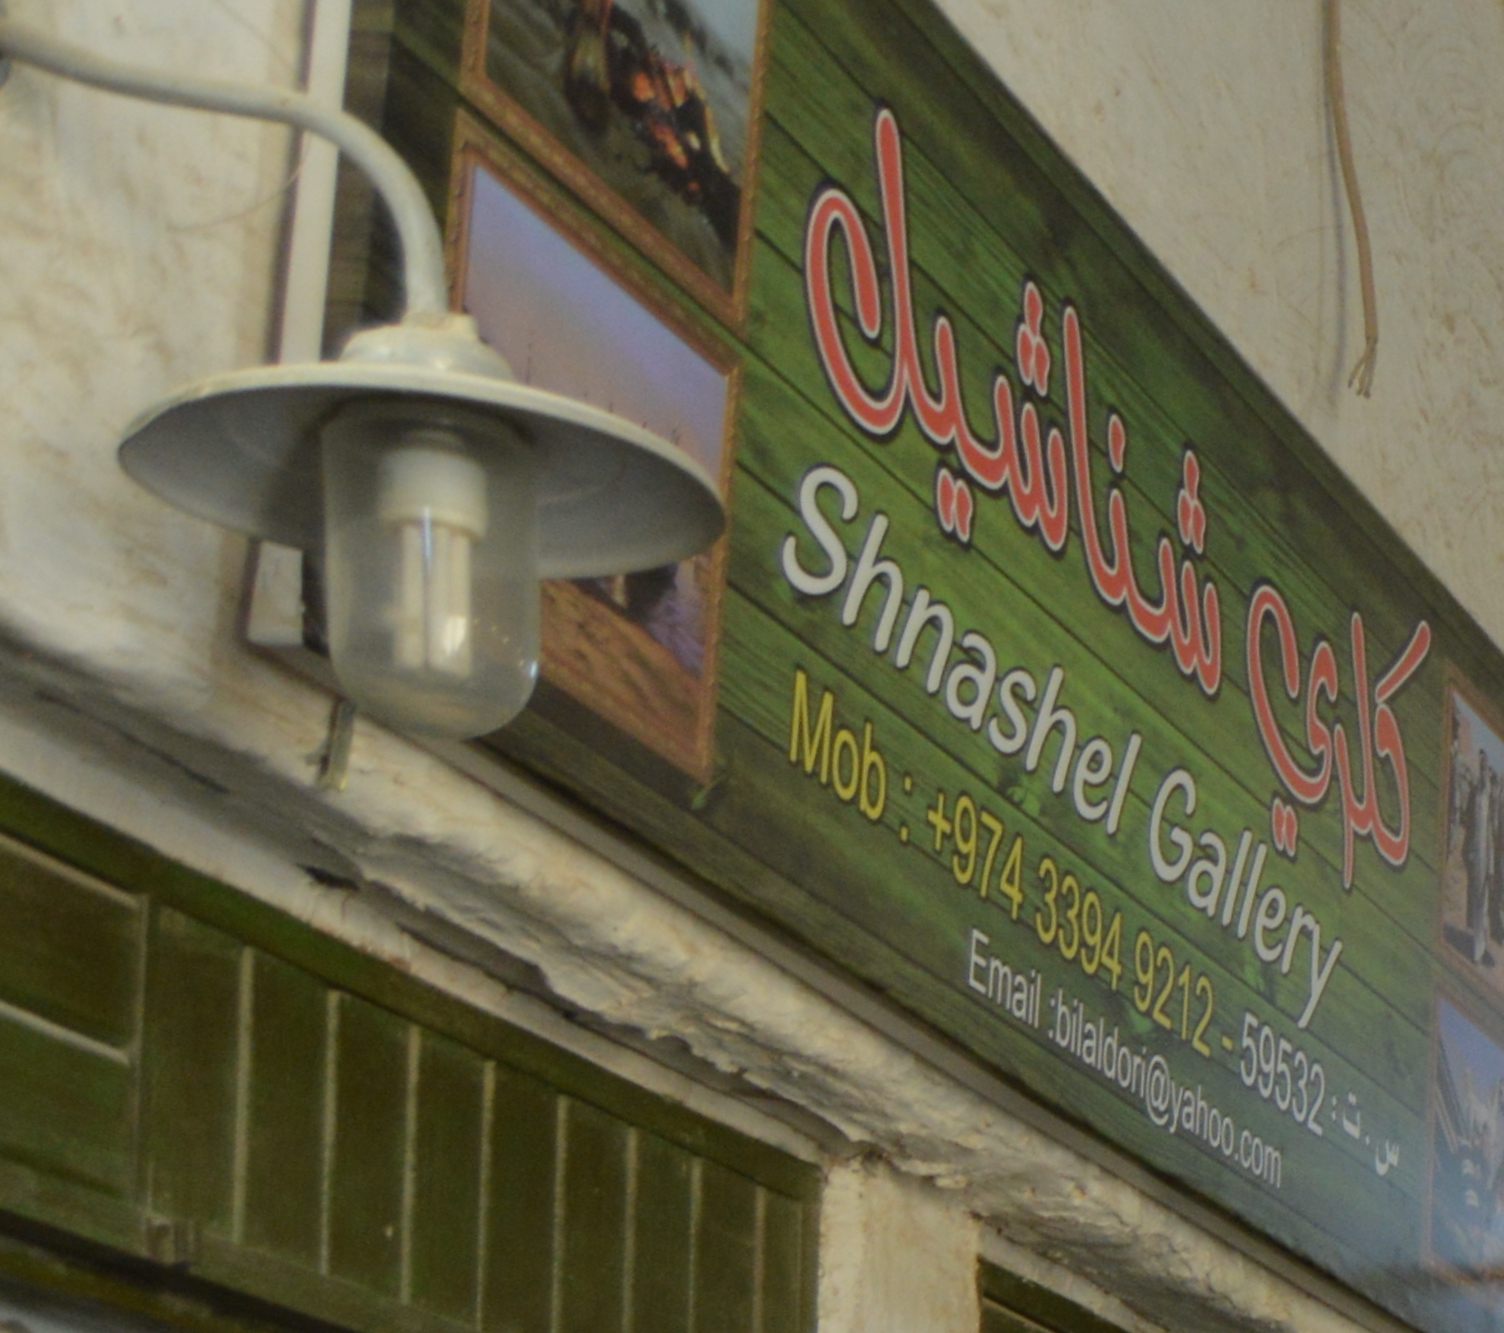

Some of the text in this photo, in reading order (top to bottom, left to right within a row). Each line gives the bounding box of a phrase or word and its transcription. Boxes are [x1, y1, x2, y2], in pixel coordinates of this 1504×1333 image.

[781, 465, 1344, 1028] Shnashel Gallery
[789, 669, 886, 822] Mob
[927, 792, 1025, 921] +974
[1035, 857, 1124, 992] 3394
[1133, 930, 1215, 1058] 9212
[1239, 1011, 1326, 1138] 59532
[968, 927, 1040, 1029] Email
